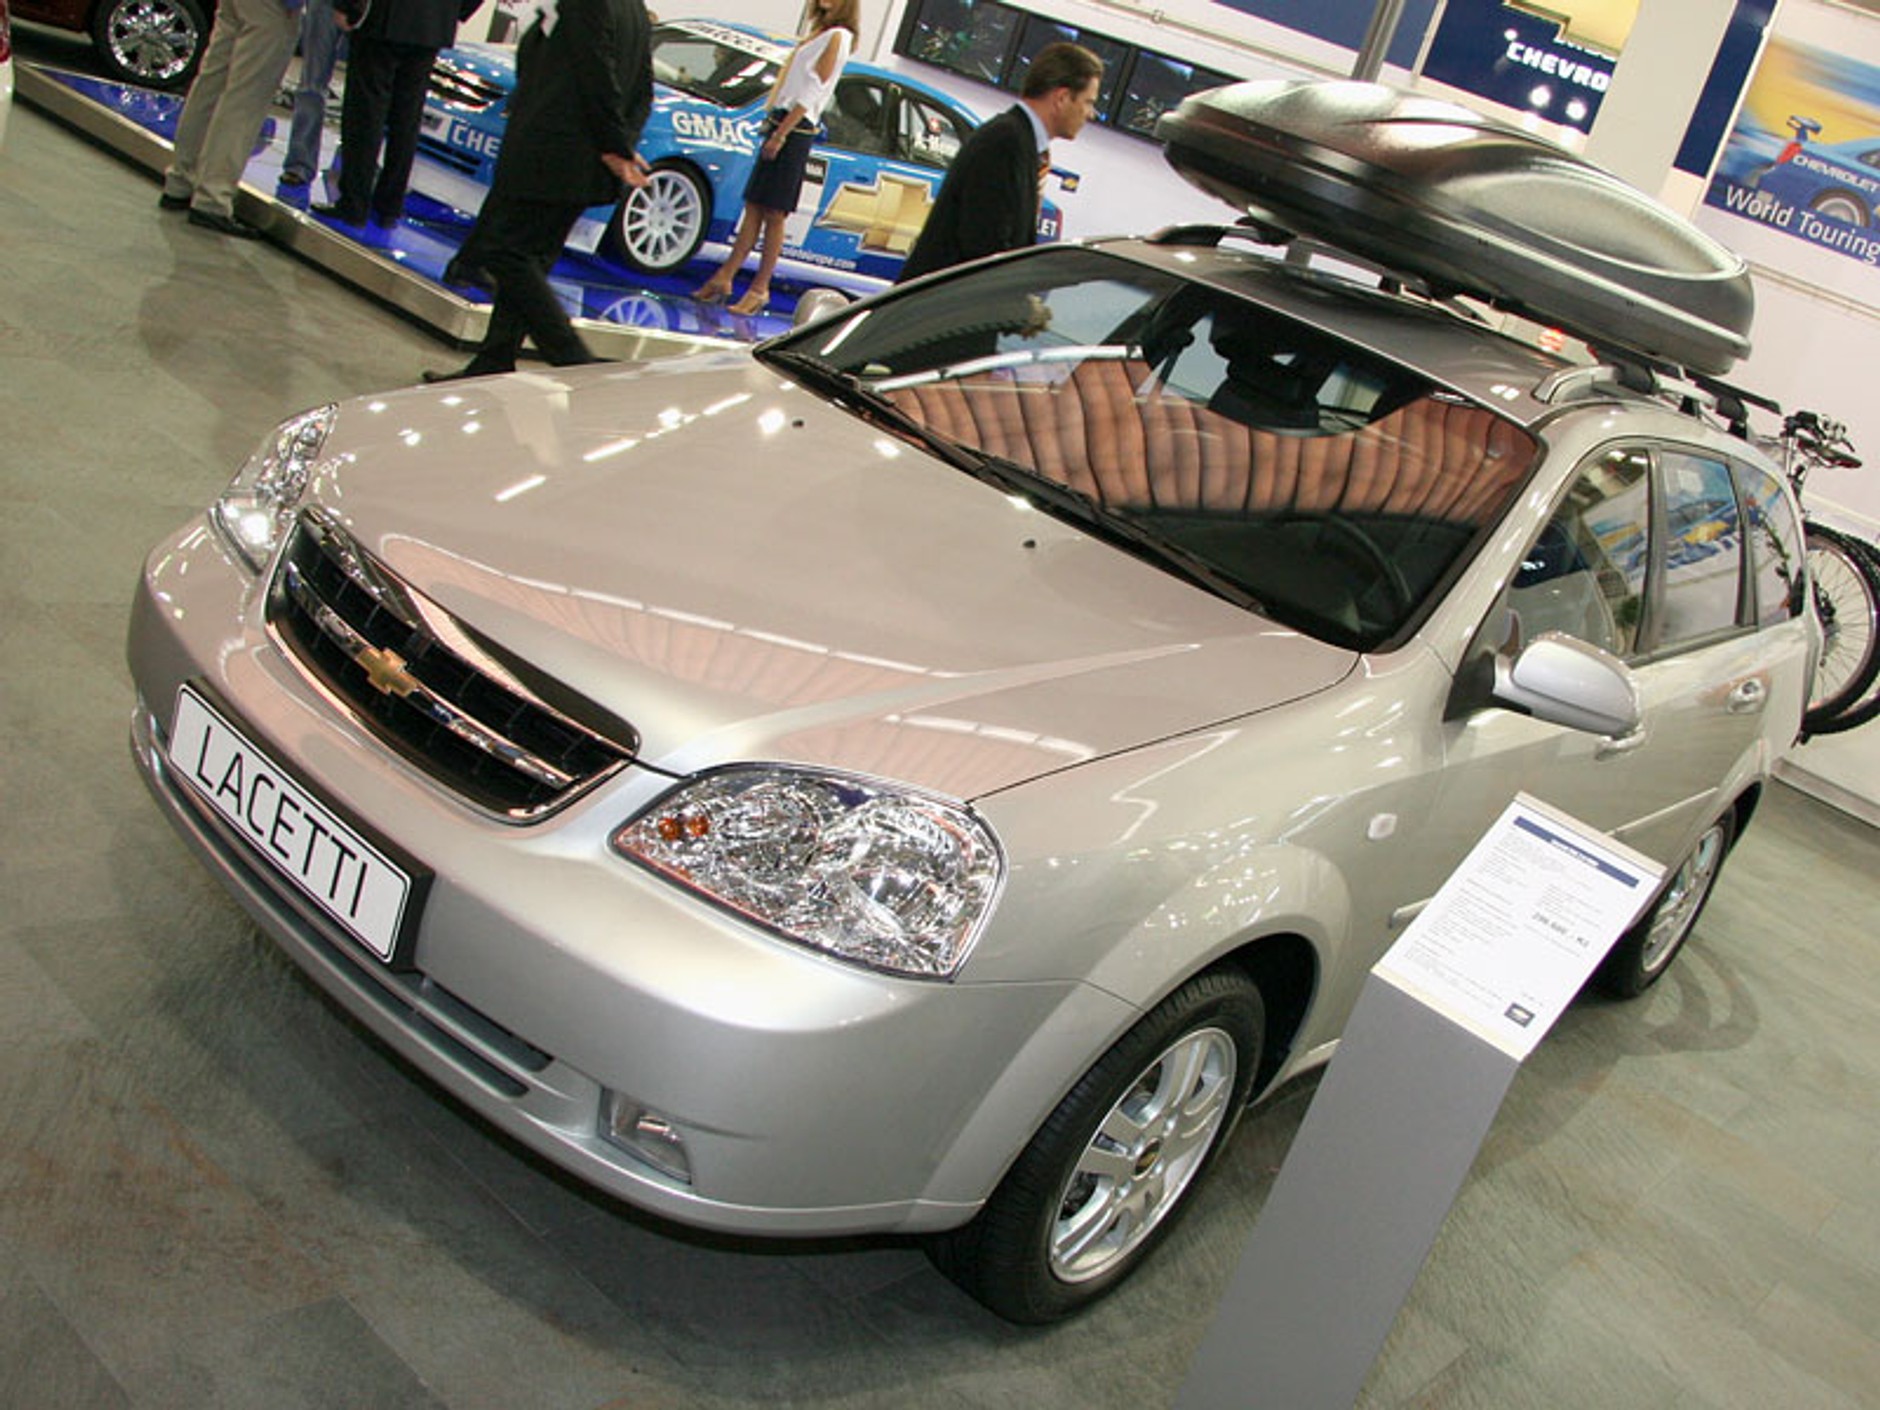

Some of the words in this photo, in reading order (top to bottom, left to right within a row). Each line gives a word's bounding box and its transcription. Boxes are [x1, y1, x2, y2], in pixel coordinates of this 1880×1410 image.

[1506, 41, 1612, 92] CHEVRO
[452, 124, 502, 158] CHE
[672, 111, 755, 149] GMAC
[1793, 154, 1879, 193] CHEVROLET
[1726, 185, 1794, 227] World
[1800, 211, 1880, 264] Touring
[197, 725, 367, 917] LACETTI
